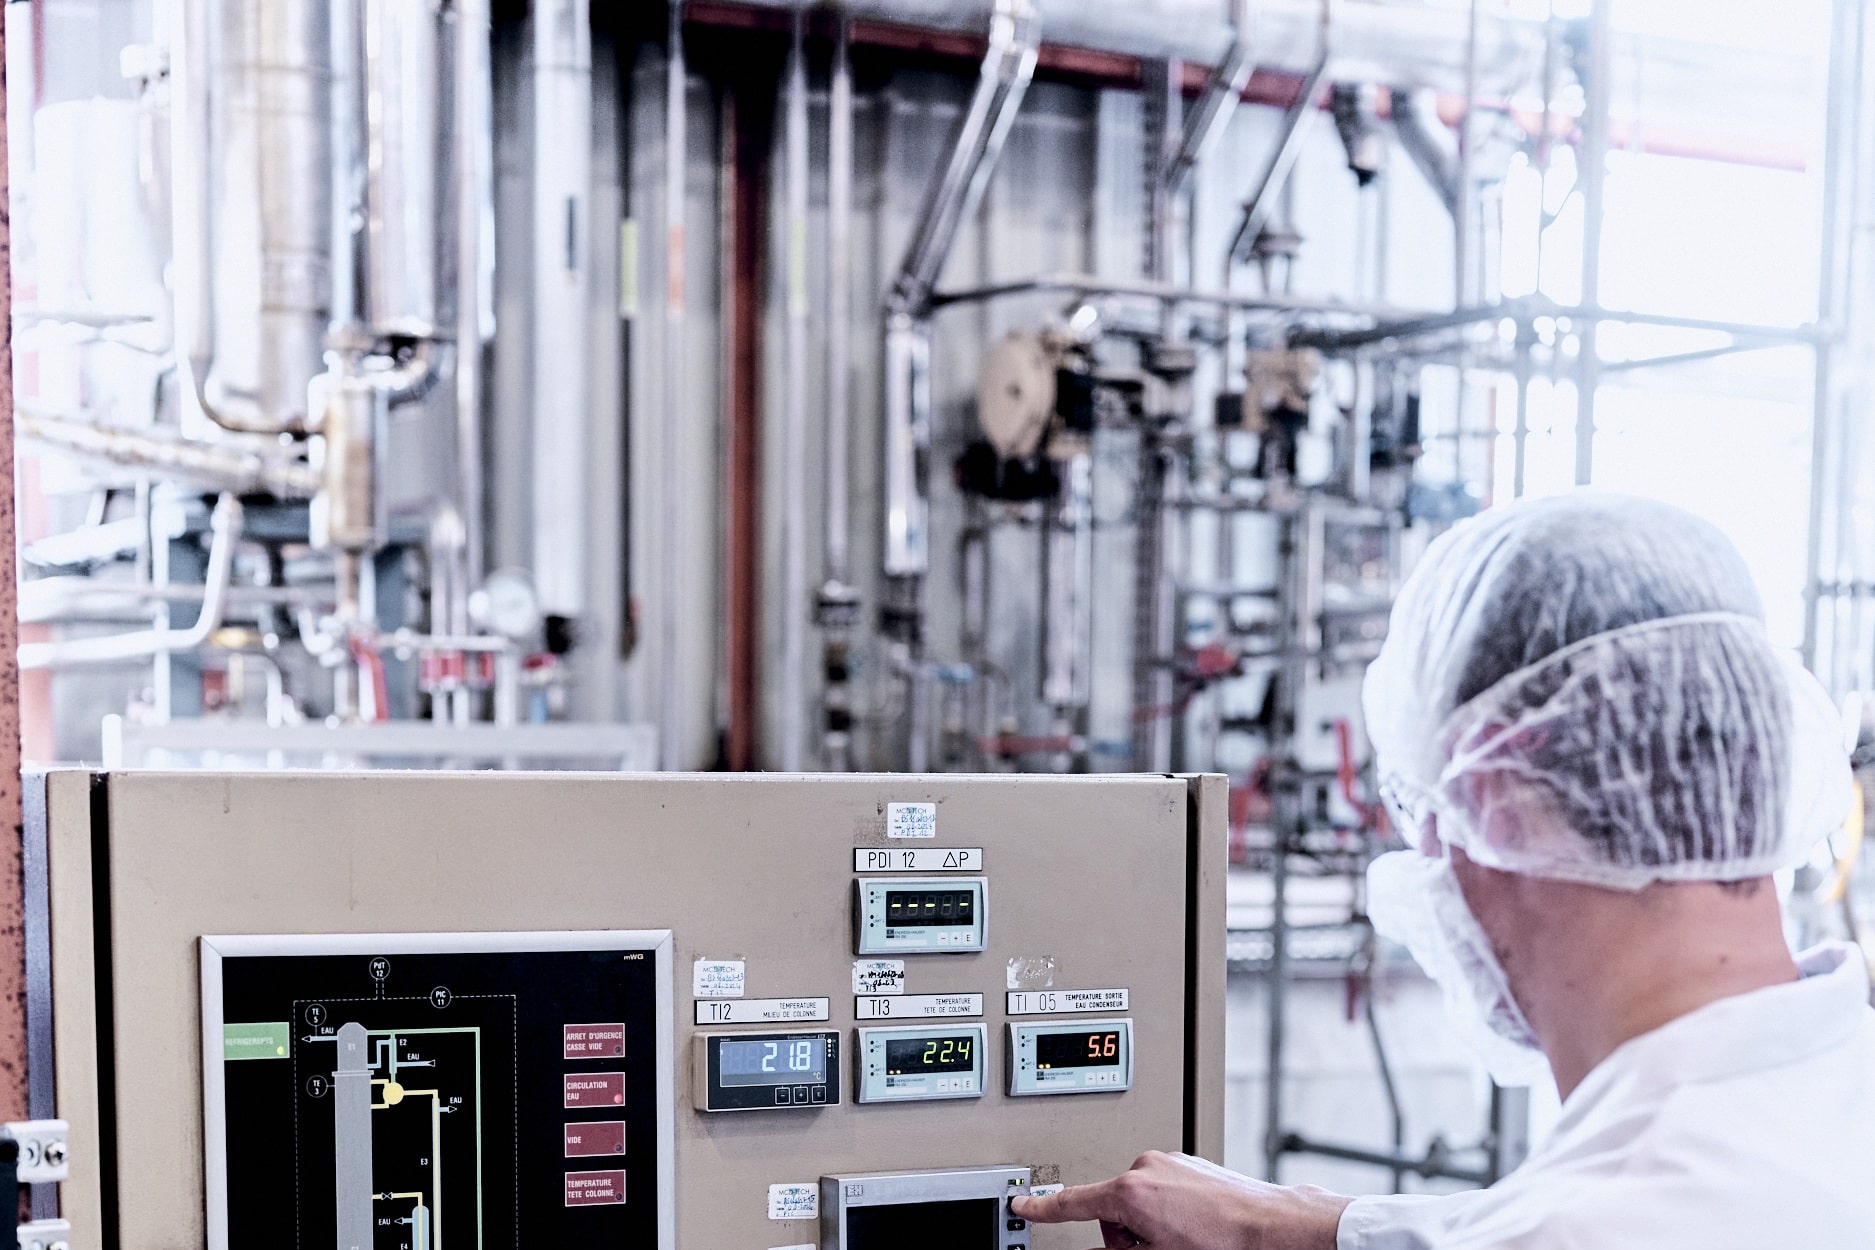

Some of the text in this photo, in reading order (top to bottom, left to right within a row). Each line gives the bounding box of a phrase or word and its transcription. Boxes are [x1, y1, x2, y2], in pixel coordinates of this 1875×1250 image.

[868, 852, 891, 868] PDI
[902, 852, 915, 868] 12
[780, 1002, 816, 1010] TEMPERATURE
[1016, 994, 1056, 1012] TI 05
[710, 1004, 732, 1020] TI2
[870, 1000, 890, 1016] TI3
[566, 1032, 586, 1040] ARRET
[1088, 1034, 1116, 1058] 5.6
[923, 1040, 970, 1064] 22.4
[567, 1082, 608, 1090] CIRCULATION
[450, 1096, 462, 1104] EAU
[567, 1136, 582, 1144] VIDE
[420, 1158, 428, 1166] E3
[568, 1179, 612, 1188] TEMPERATURE
[568, 1189, 614, 1198] TETE COLONNE
[378, 1218, 390, 1226] EAU
